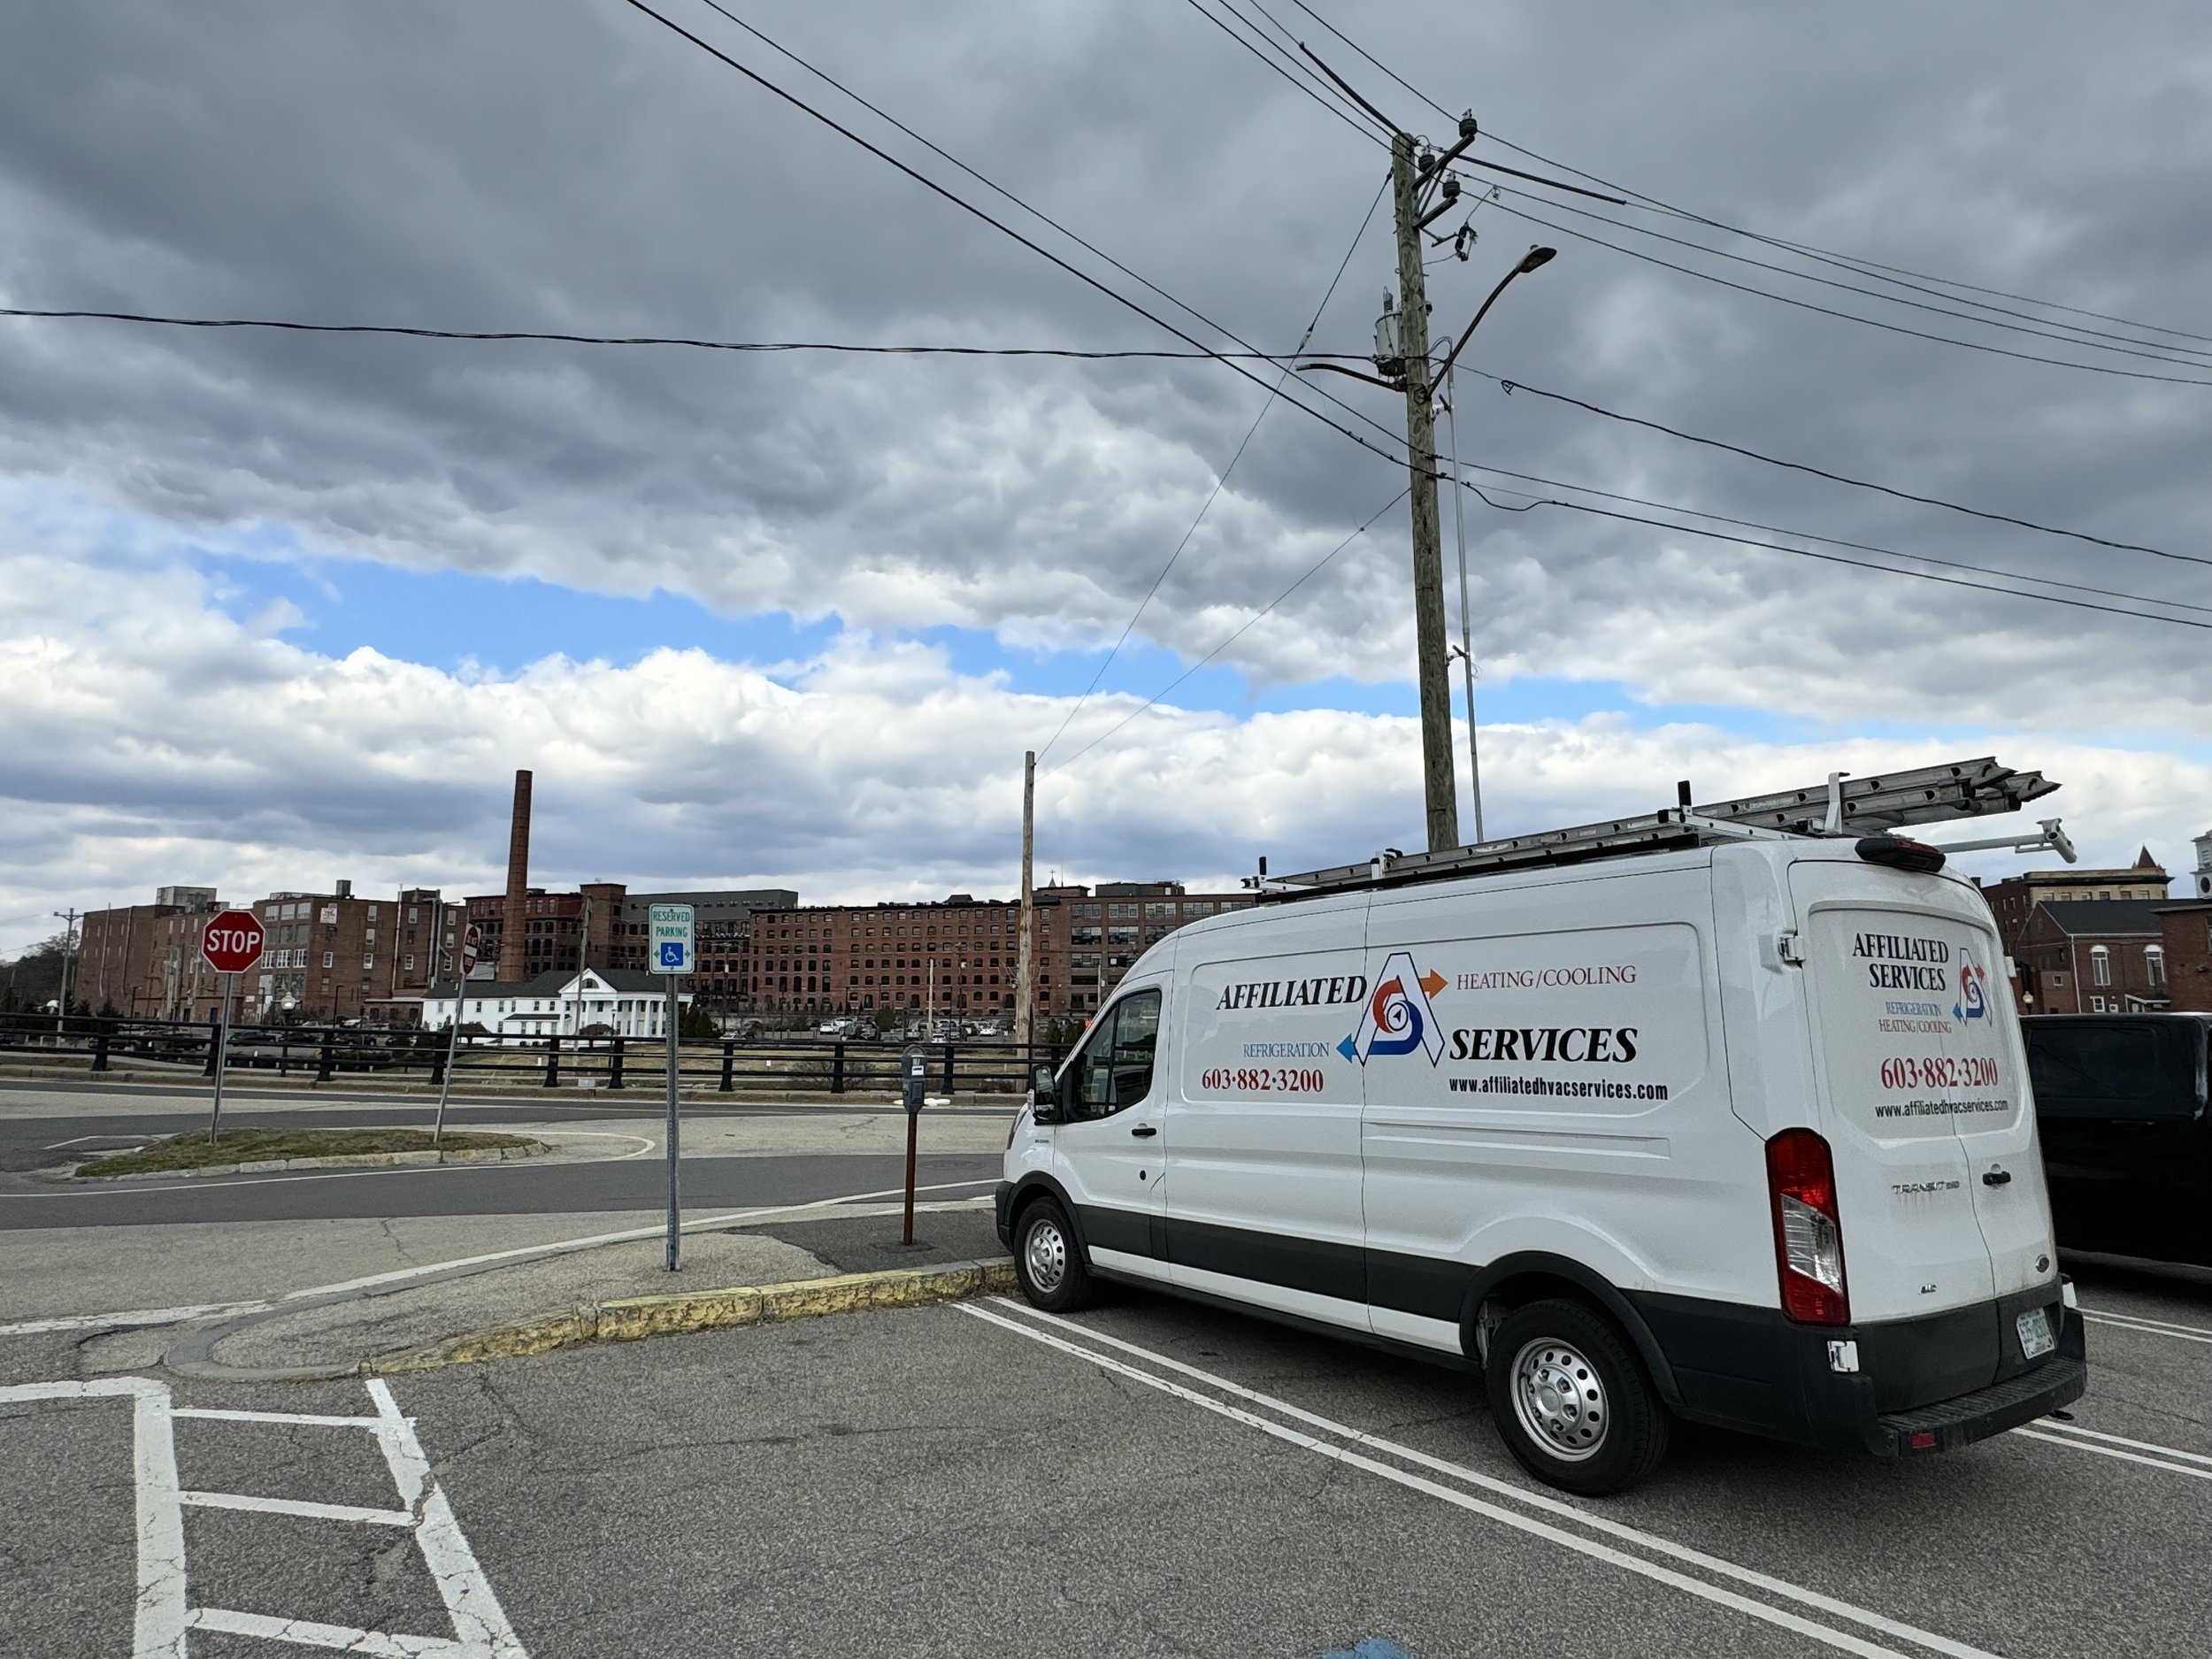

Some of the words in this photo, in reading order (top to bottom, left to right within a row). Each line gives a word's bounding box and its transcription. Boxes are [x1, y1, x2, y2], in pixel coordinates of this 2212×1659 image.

[653, 910, 690, 922] RESERVED
[206, 929, 260, 954] STOP
[656, 926, 687, 938] PARKING
[1853, 933, 1949, 964] AFFILIATED
[1456, 965, 1636, 990] HEATING/COOLING
[1869, 963, 1946, 992] SERVICES
[1216, 975, 1367, 1010] AFFILIATED
[1886, 1002, 1942, 1017] REFRIGERATION
[1878, 1018, 1952, 1033] HEATING/COOLING
[1243, 1042, 1329, 1057] REFRIGERATION
[1449, 1028, 1638, 1063] SERVICES
[1449, 1076, 1668, 1100] www.affiliatedhvacservices.com
[1875, 1098, 2008, 1118] www.affiliatedhvacservices.com
